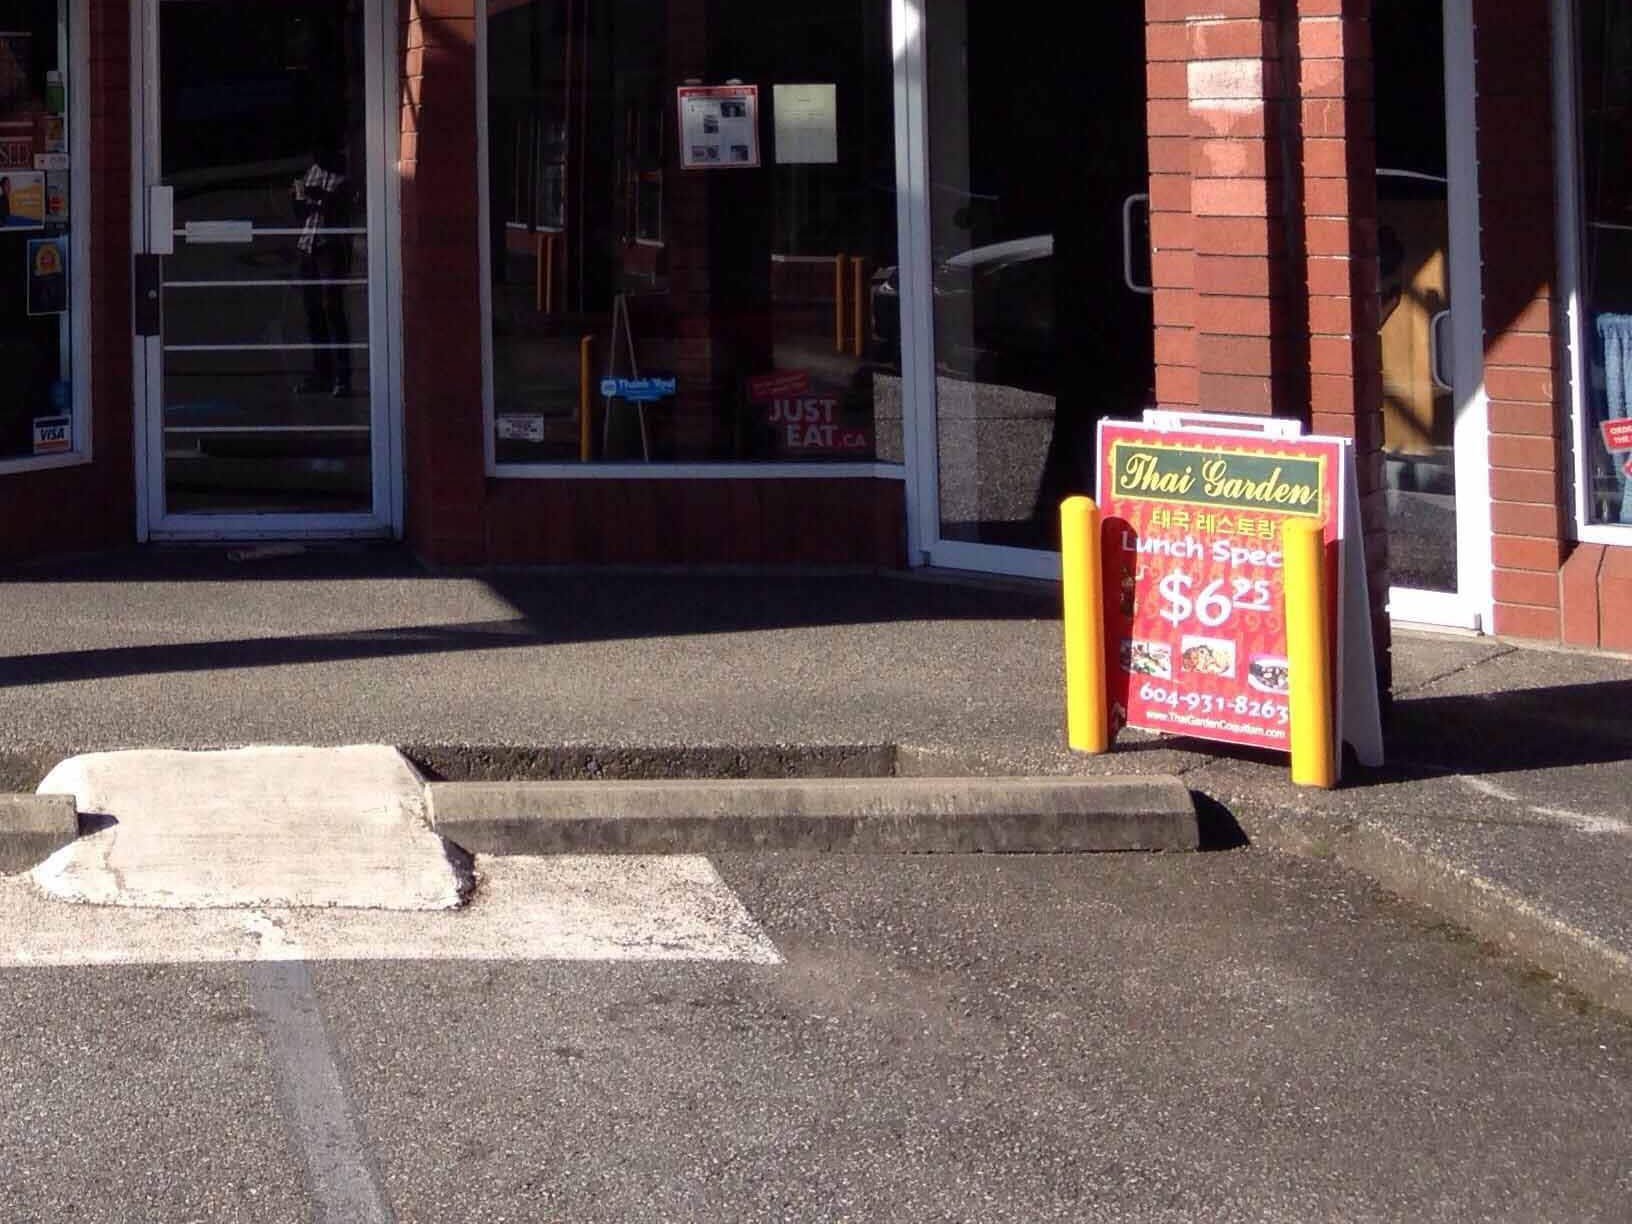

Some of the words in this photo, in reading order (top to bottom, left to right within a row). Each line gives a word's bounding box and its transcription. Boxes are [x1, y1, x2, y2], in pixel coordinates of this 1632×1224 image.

[768, 399, 838, 423] JUST
[39, 427, 65, 441] VISA
[1120, 453, 1197, 495] Thai
[1201, 459, 1318, 506] Garden
[1121, 531, 1204, 558] Lunch
[1212, 539, 1282, 568] Spec
